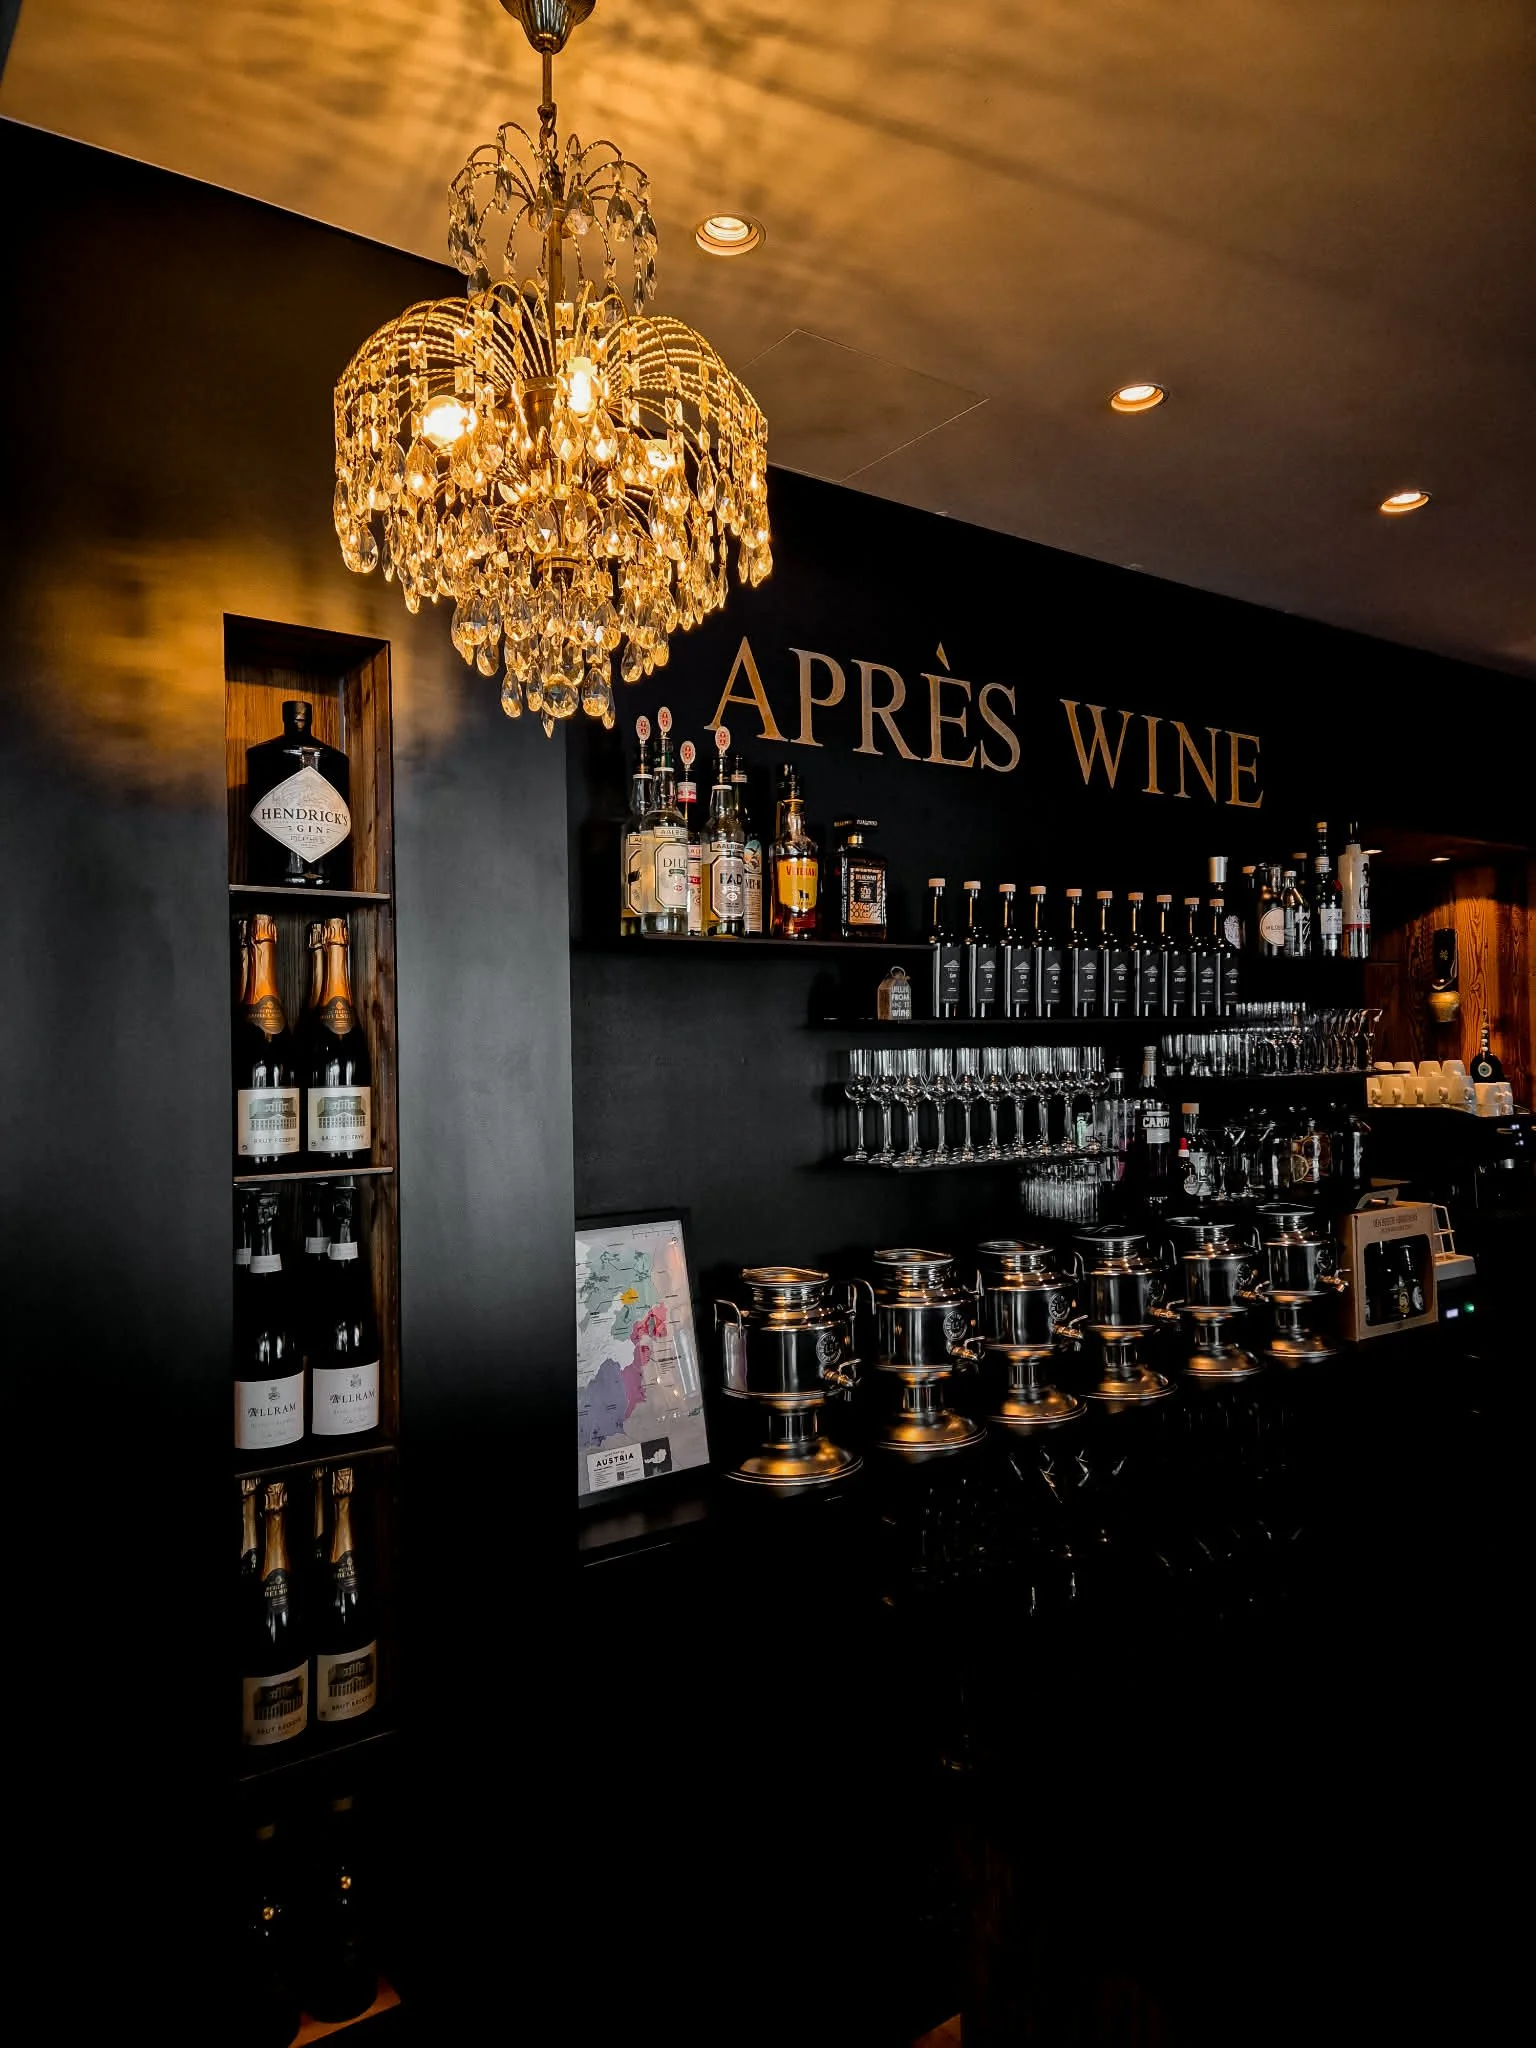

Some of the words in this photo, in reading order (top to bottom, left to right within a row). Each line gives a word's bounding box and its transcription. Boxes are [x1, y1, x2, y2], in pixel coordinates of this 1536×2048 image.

[704, 635, 1021, 773] APRÈS
[1060, 698, 1265, 809] WINE
[261, 807, 348, 826] HENDRICK'S
[296, 824, 323, 834] GIN
[595, 1452, 634, 1467] AUSTRIA
